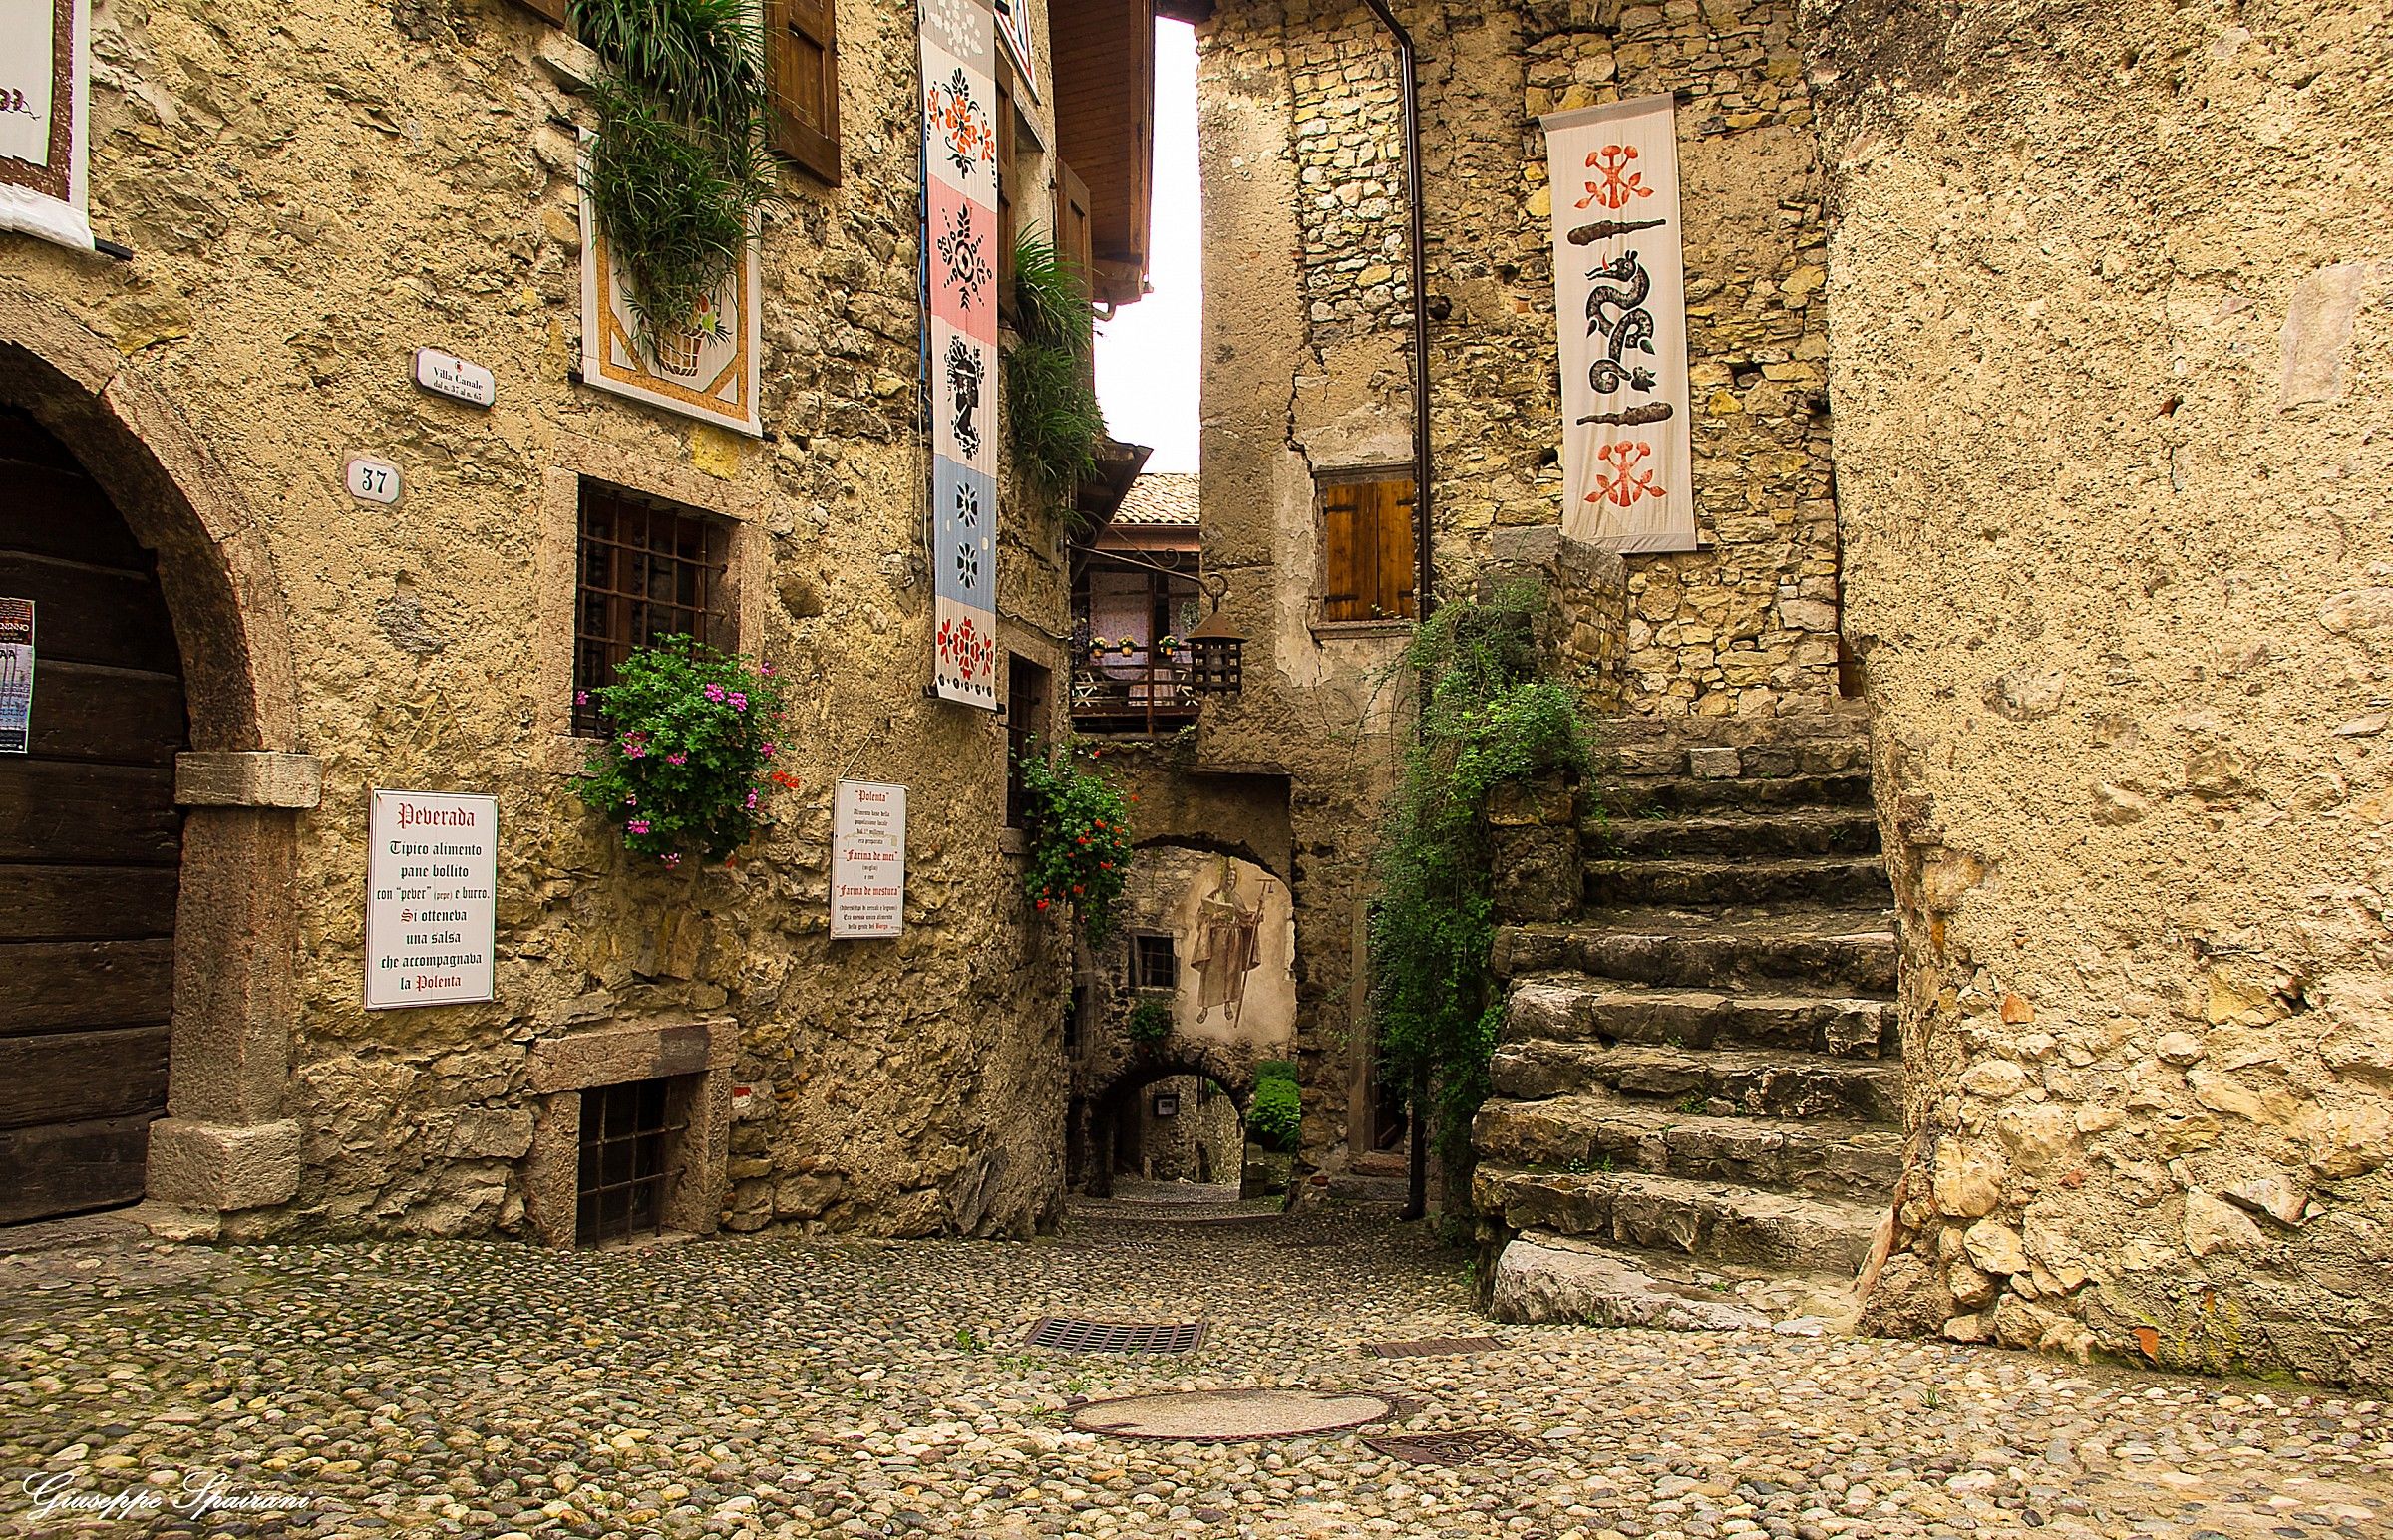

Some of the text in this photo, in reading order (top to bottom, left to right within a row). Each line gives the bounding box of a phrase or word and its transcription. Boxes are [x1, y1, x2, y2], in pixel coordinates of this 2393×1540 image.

[433, 367, 484, 390] Villa Canale
[433, 380, 443, 389] dal
[451, 385, 459, 394] 37
[362, 467, 387, 493] 37
[855, 789, 889, 802] "Polenta"
[397, 802, 475, 829] Peverada
[390, 840, 482, 856] Tipico alimento
[843, 849, 871, 861] "Farina
[873, 850, 881, 860] de
[401, 864, 469, 879] pane bollito
[377, 889, 393, 900] con
[434, 892, 453, 901] (pepe)
[455, 889, 460, 899] e
[463, 886, 490, 899] burro.
[836, 884, 862, 897] "Farina
[863, 885, 871, 896] de
[401, 908, 467, 922] Si otteneva
[406, 930, 461, 945] una salsa
[381, 953, 482, 969] che accompagnava
[400, 975, 461, 992] la Polenta
